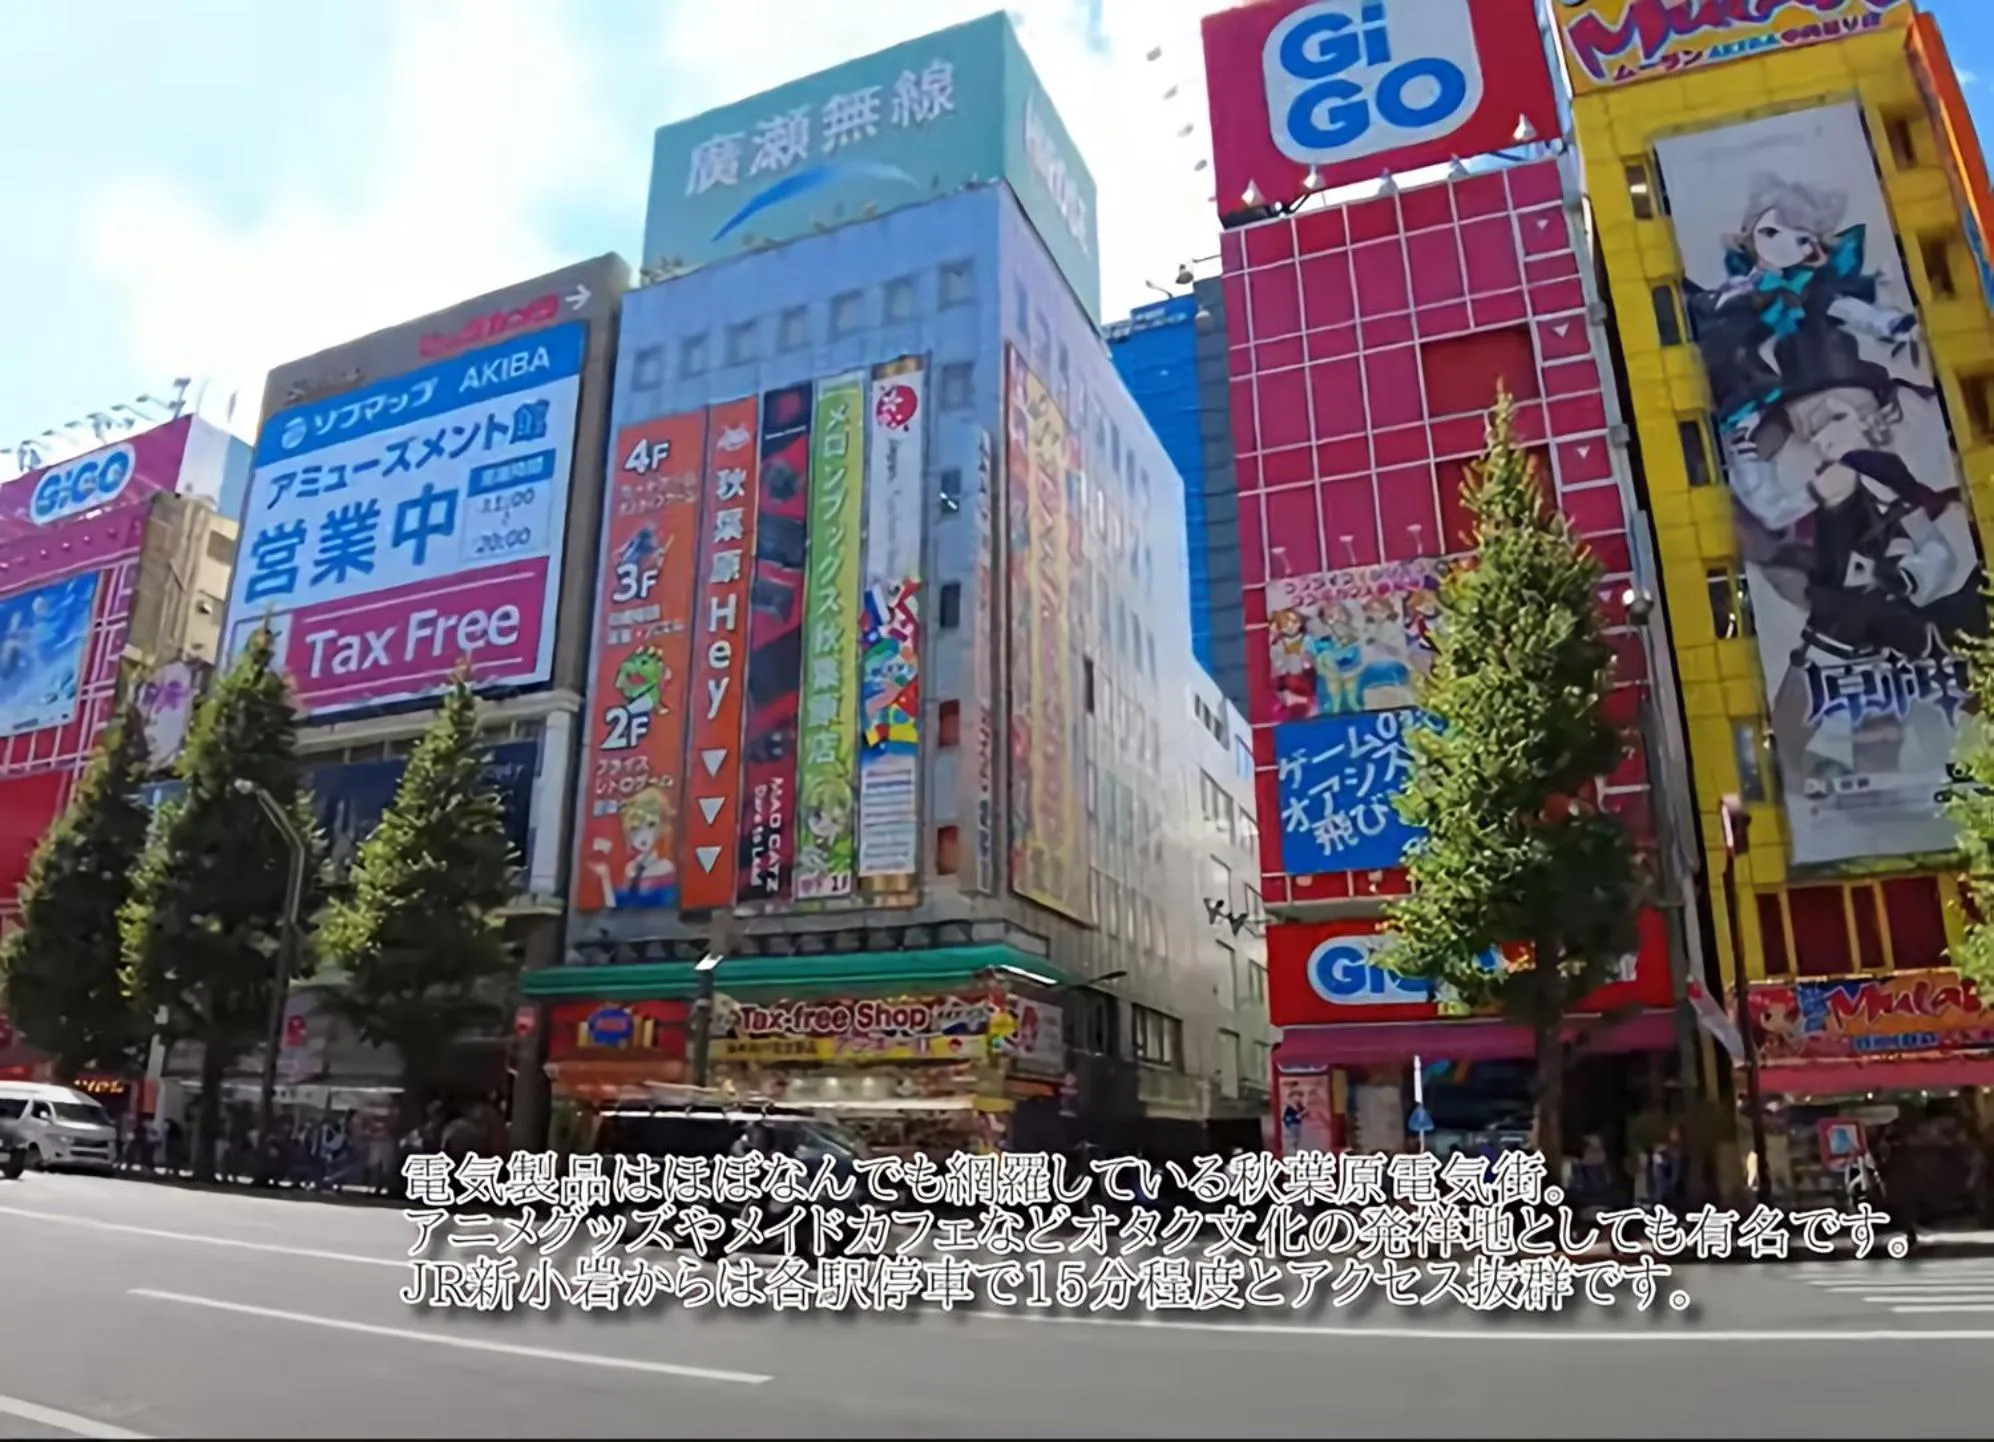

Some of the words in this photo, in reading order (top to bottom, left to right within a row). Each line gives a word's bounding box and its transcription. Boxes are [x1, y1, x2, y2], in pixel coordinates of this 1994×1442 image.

[1287, 57, 1467, 149] GO
[458, 345, 551, 394] AKIBA
[267, 398, 550, 510] アミューズメント館
[624, 438, 669, 473] 4F
[244, 482, 459, 604] 営業中
[612, 563, 658, 602] 3F
[305, 625, 397, 679] Tax
[404, 604, 520, 662] Free
[600, 706, 650, 750] 2F
[855, 1000, 931, 1031] Shop
